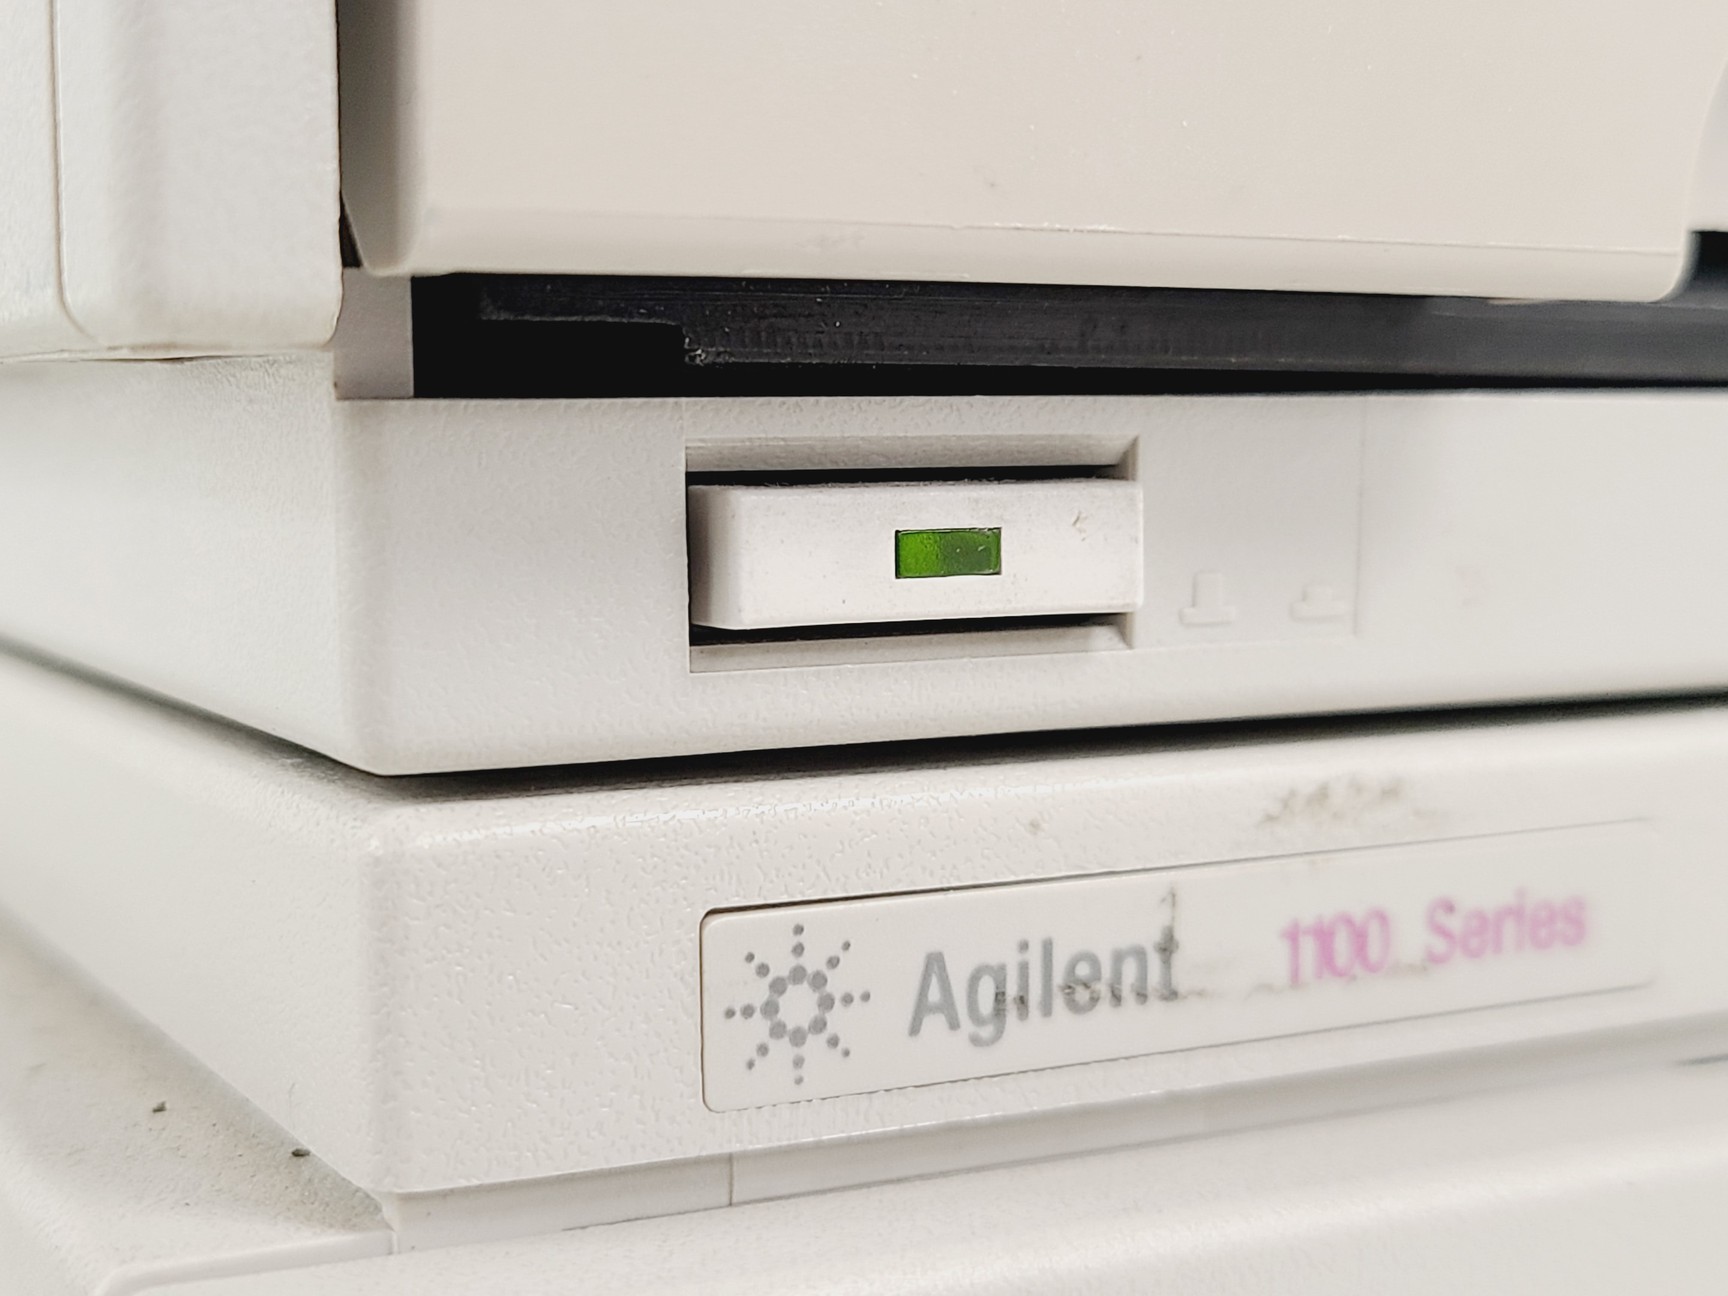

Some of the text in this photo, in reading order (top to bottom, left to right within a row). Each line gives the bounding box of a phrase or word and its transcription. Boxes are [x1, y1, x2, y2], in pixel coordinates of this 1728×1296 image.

[907, 887, 1589, 1047] Agilent 1100 Series
